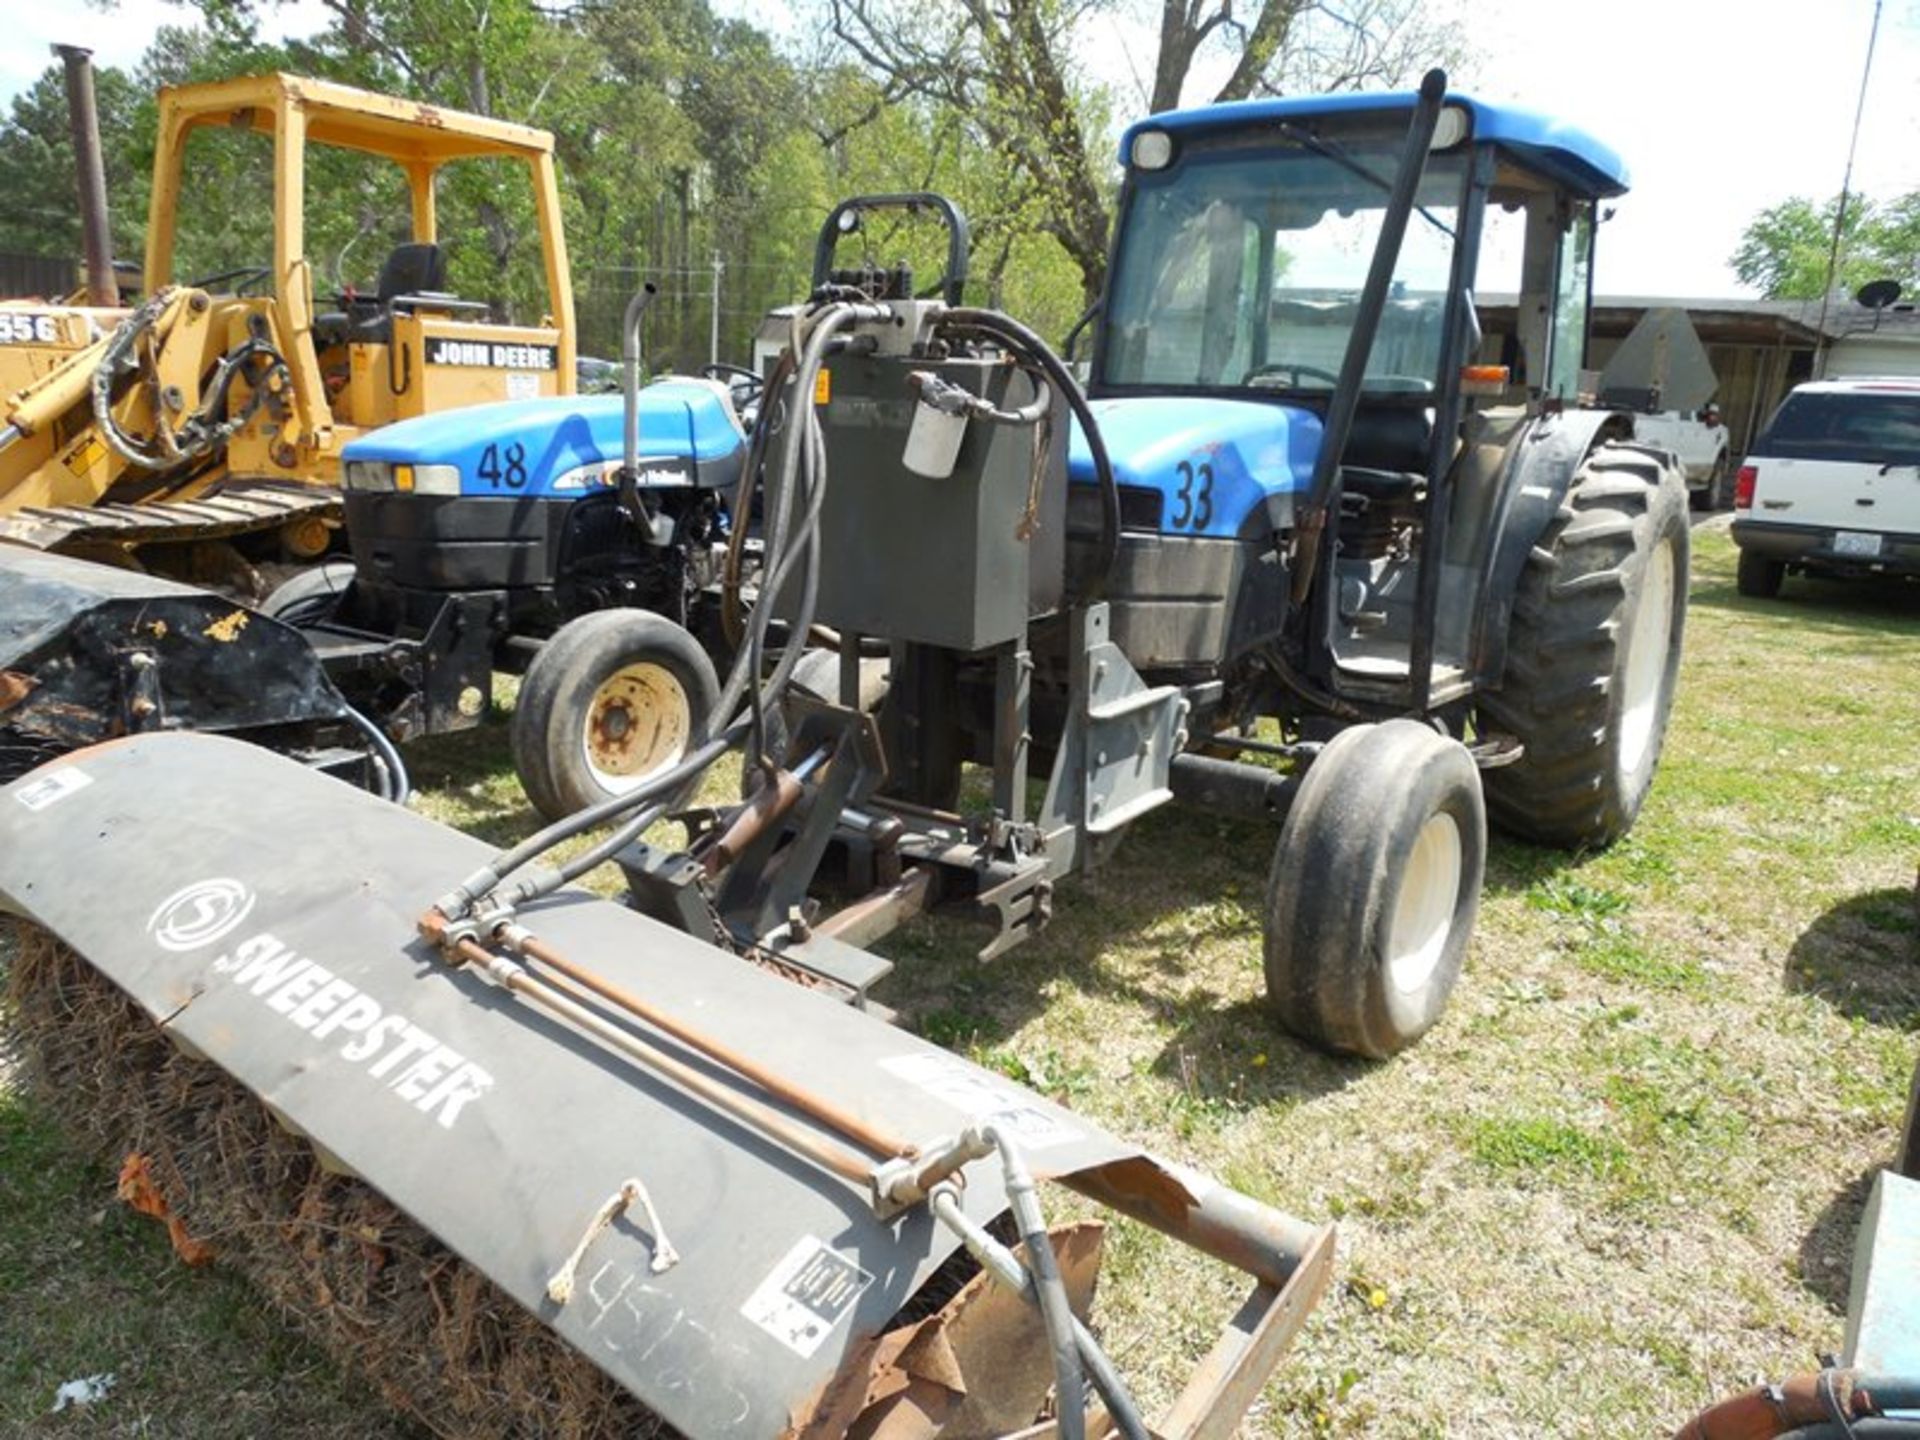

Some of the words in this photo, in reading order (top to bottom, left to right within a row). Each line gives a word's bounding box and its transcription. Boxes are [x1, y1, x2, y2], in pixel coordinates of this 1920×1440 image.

[433, 341, 489, 365] JOHN
[492, 345, 552, 369] DEERE
[478, 442, 527, 488] 48
[1171, 460, 1213, 531] 33
[213, 932, 494, 1130] SWEEPSTER
